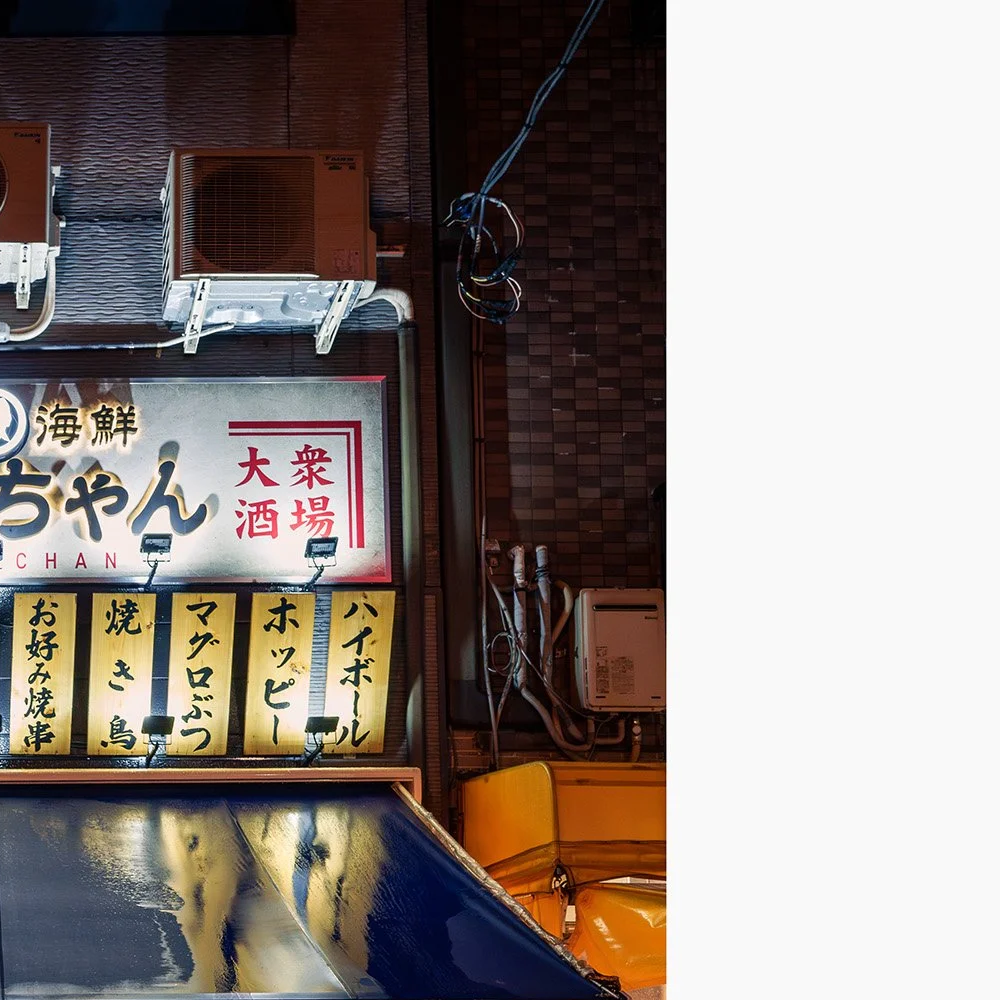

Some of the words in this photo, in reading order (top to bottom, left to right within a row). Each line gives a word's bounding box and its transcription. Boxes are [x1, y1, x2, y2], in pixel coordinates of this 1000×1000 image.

[35, 404, 138, 448] 海鮮
[23, 598, 60, 751] お好み焼串
[100, 598, 142, 749] 焼き鳥
[181, 600, 221, 752] マグロぶつ
[263, 597, 300, 745] ホッピー
[335, 600, 378, 748] ハイボール
